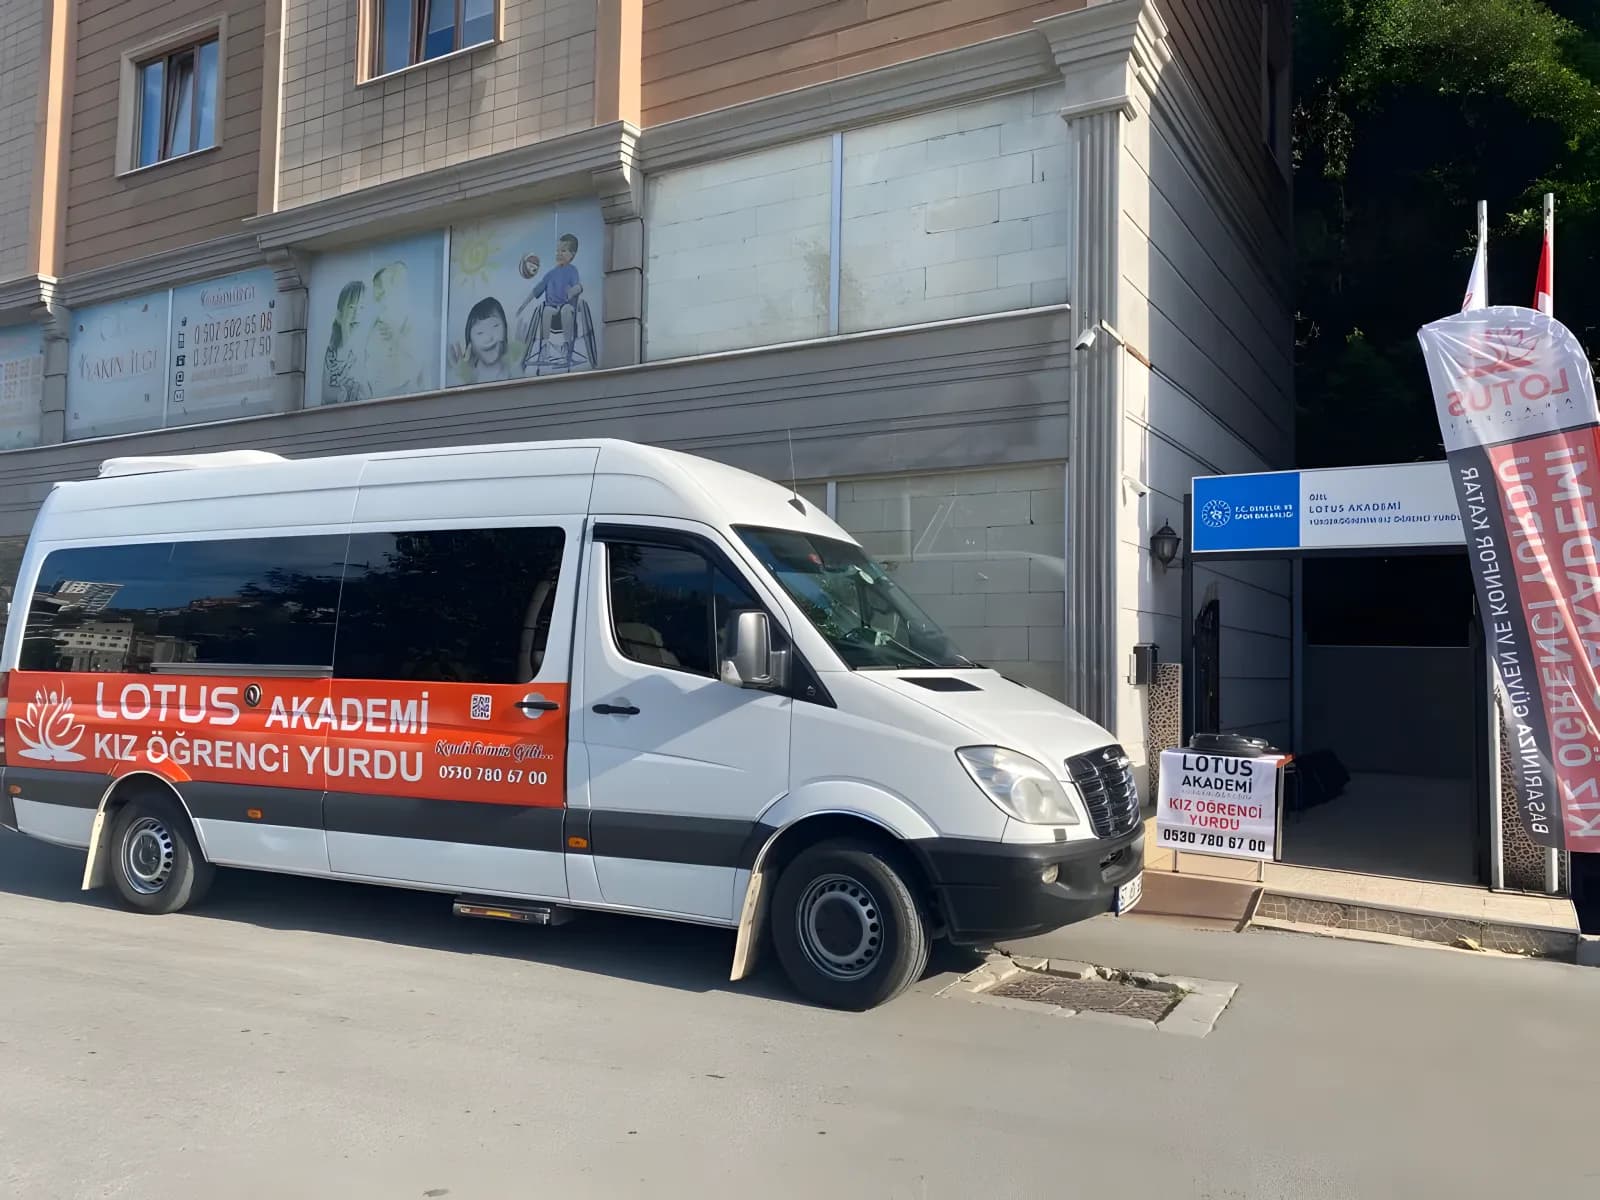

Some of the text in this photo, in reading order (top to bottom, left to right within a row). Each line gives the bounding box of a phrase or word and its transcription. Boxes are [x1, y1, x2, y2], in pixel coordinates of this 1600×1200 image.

[1309, 504, 1344, 514] LOTUS
[96, 681, 429, 735] LOTUS AKADEMİ
[94, 732, 138, 762] KIZ
[299, 745, 423, 782] YURDU
[1182, 754, 1253, 777] LOTUS
[439, 765, 547, 785] 0530 780 67 00
[1181, 775, 1253, 794] AKADEMİ
[1169, 797, 1192, 812] KIZ
[1189, 814, 1240, 831] YURDU
[1163, 828, 1266, 852] 0530 780 67 00
